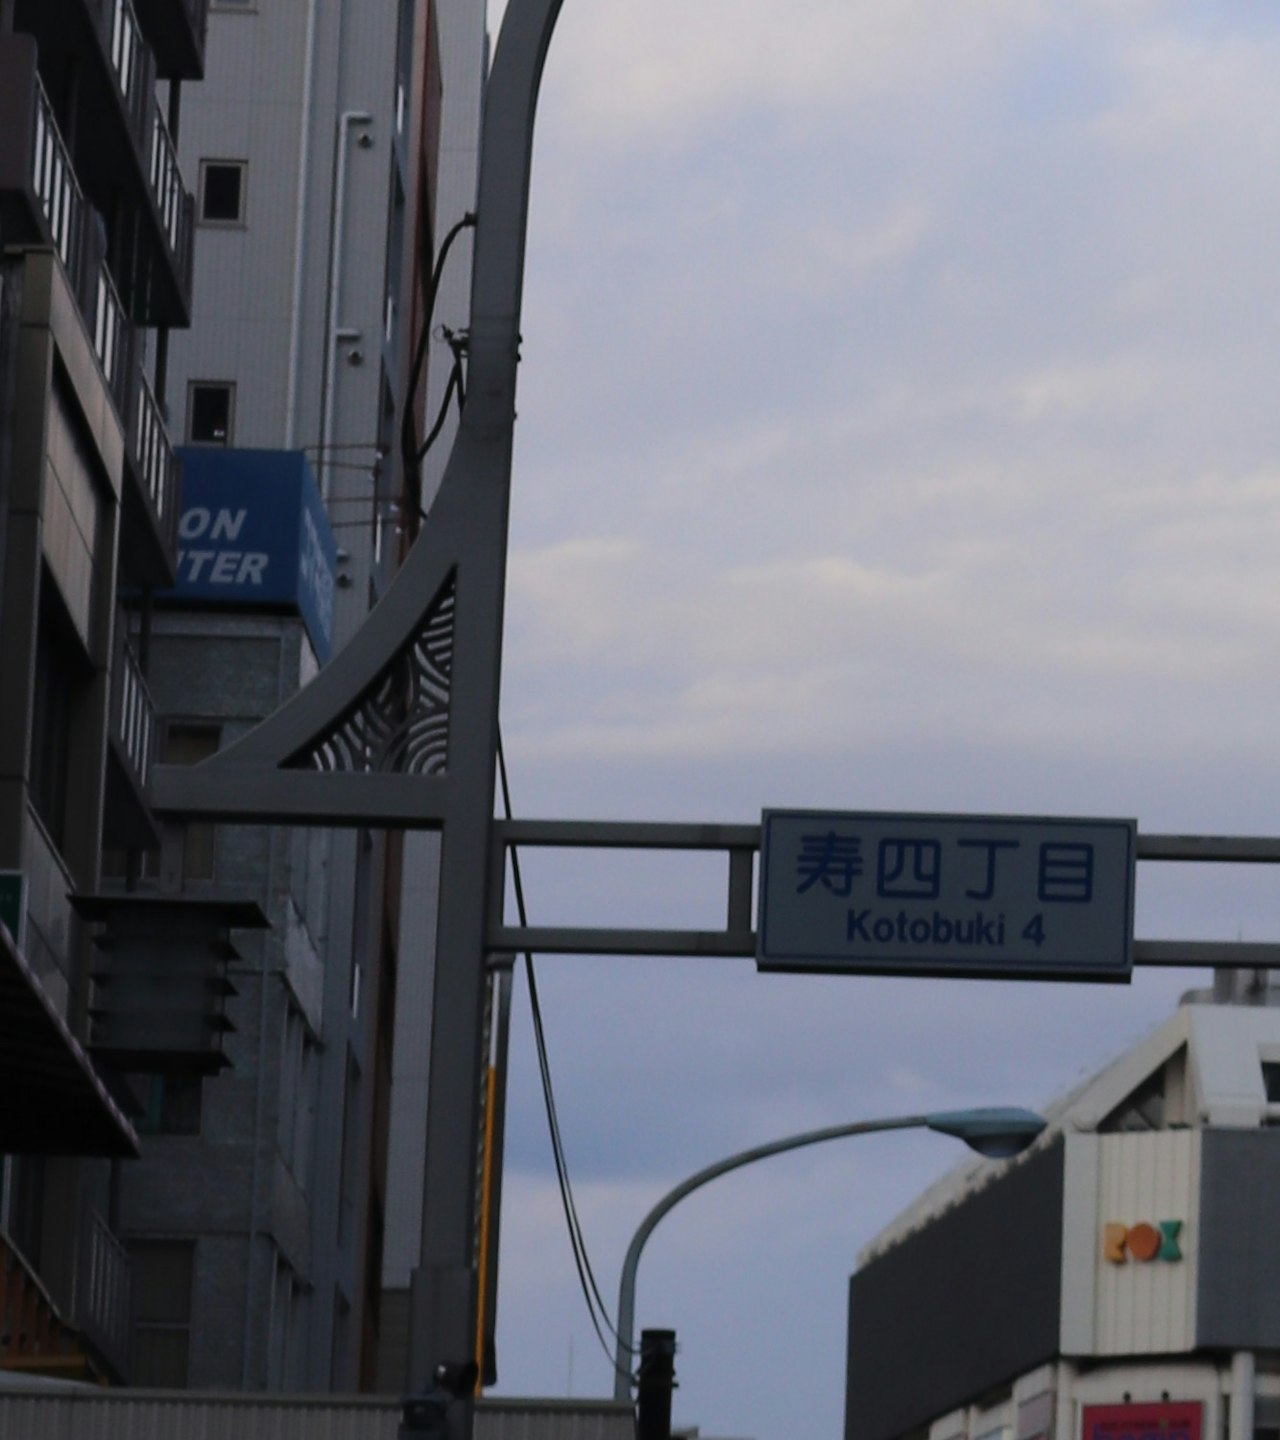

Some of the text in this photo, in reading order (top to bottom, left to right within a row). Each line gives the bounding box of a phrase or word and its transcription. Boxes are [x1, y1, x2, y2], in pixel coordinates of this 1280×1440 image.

[796, 830, 1094, 903] 寿四丁目
[846, 909, 1046, 947] Kotobuki 4
